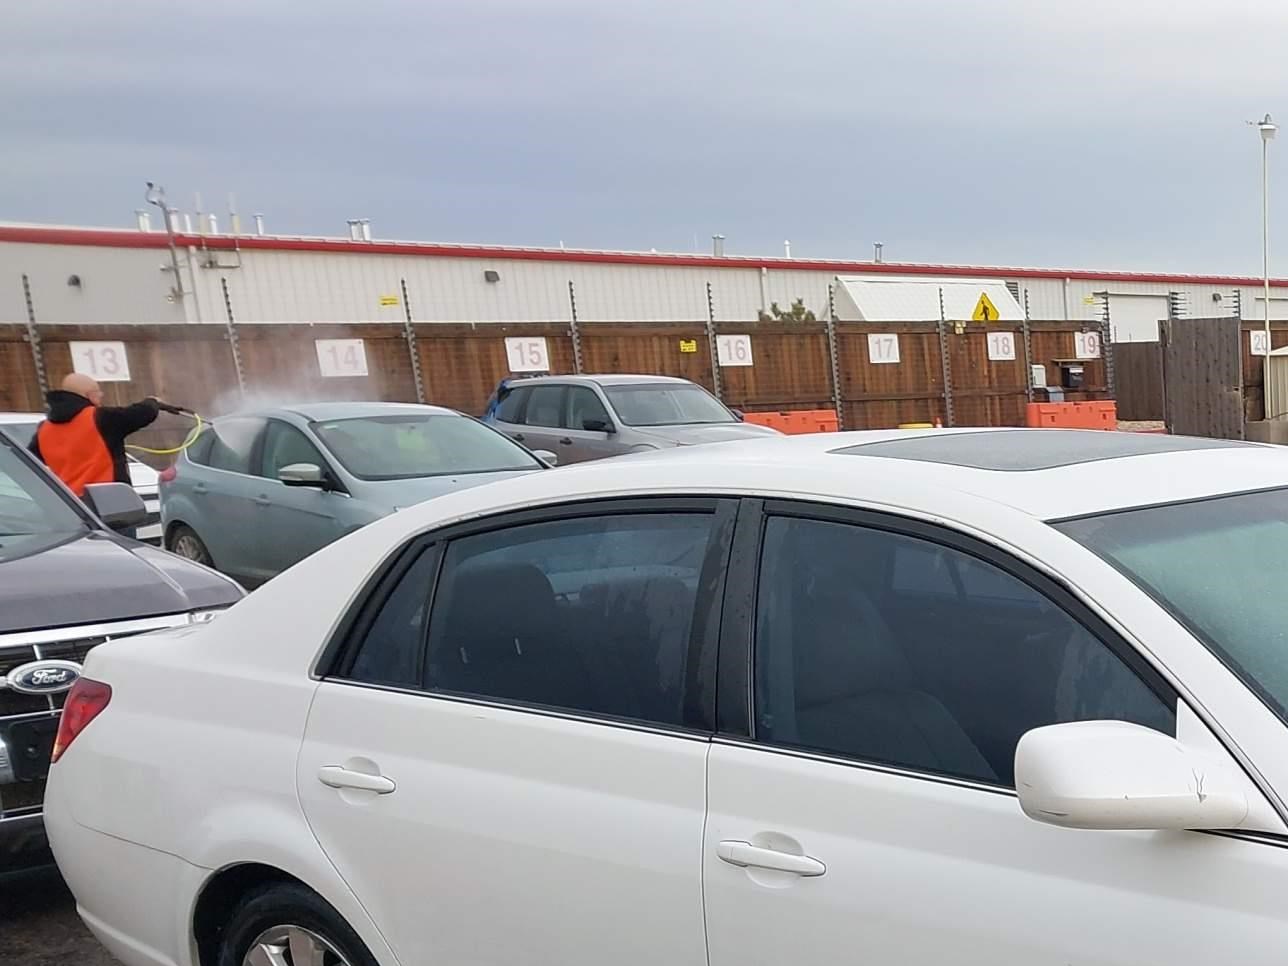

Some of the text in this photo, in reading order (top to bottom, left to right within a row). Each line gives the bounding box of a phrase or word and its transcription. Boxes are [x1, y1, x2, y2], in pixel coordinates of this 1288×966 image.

[513, 341, 542, 366] 15
[724, 339, 746, 361] 16
[874, 338, 894, 359] 17
[992, 335, 1010, 356] 18
[1080, 335, 1097, 354] 19
[82, 346, 121, 375] 13
[327, 345, 359, 372] 14
[31, 668, 68, 685] Ford
